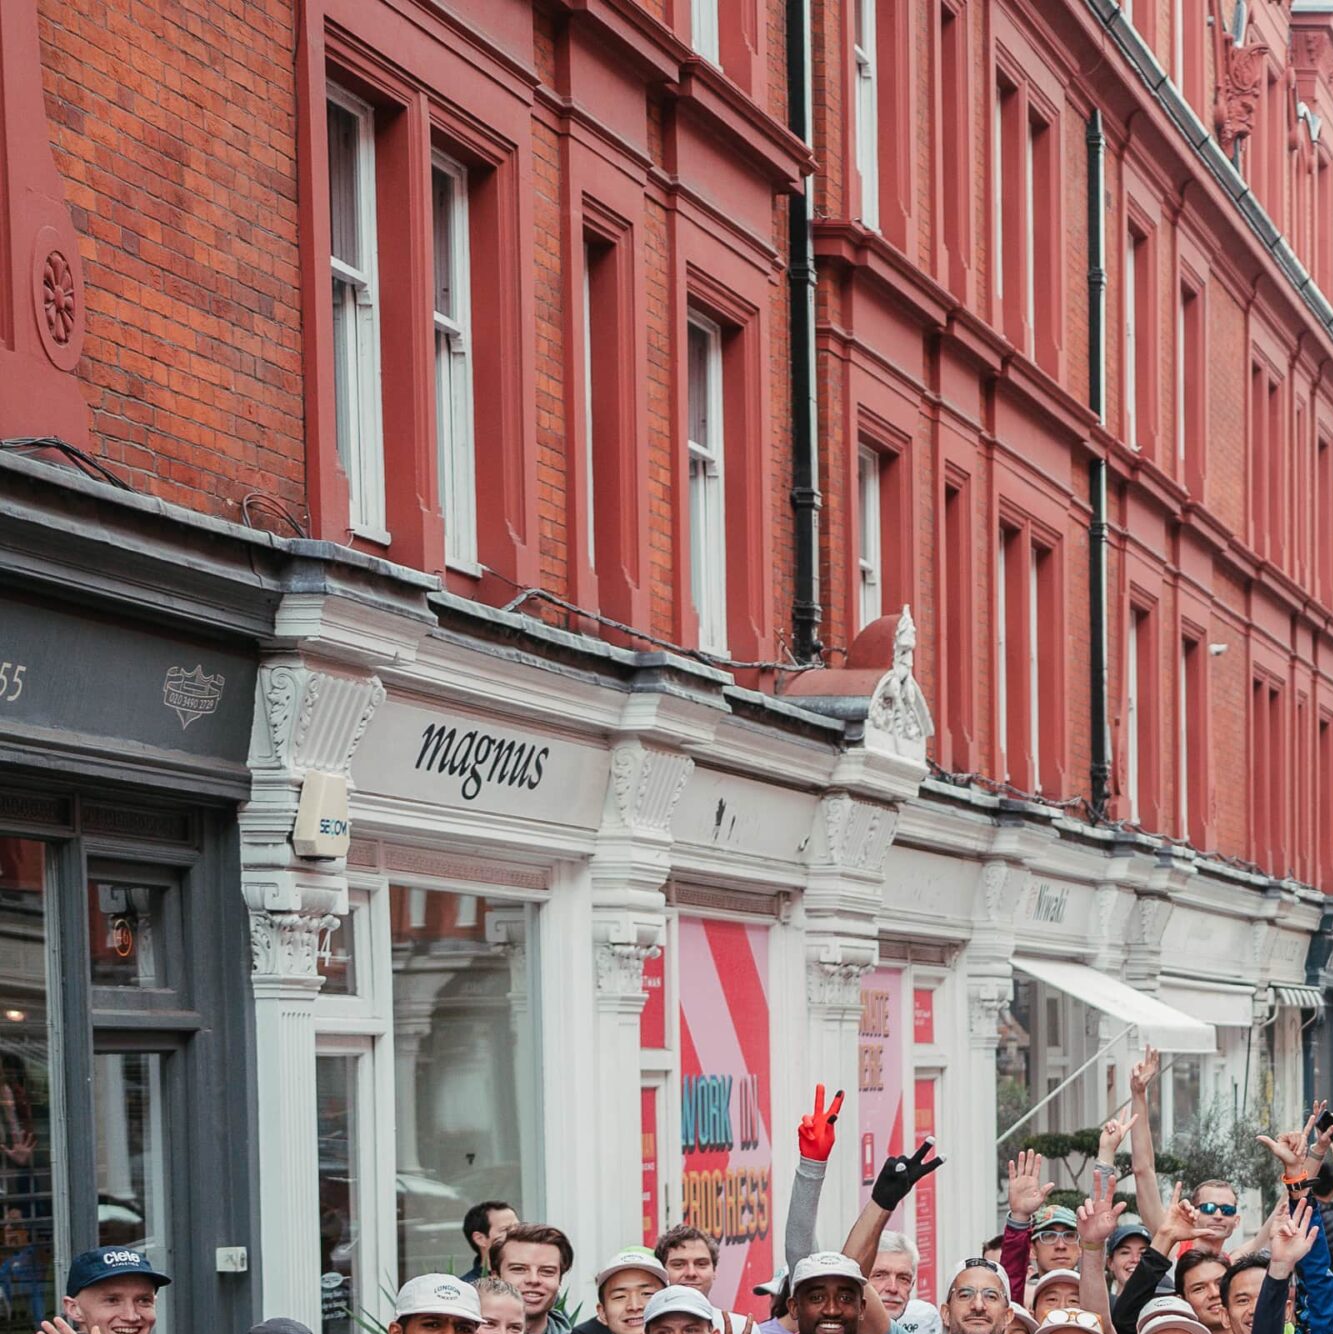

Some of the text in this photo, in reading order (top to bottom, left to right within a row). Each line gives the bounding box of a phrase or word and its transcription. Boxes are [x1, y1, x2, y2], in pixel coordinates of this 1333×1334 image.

[414, 722, 550, 801] magnus
[319, 818, 347, 836] SECOM
[681, 1074, 733, 1154] WORK
[104, 1250, 141, 1264] ciele
[433, 1284, 461, 1297] LONDON
